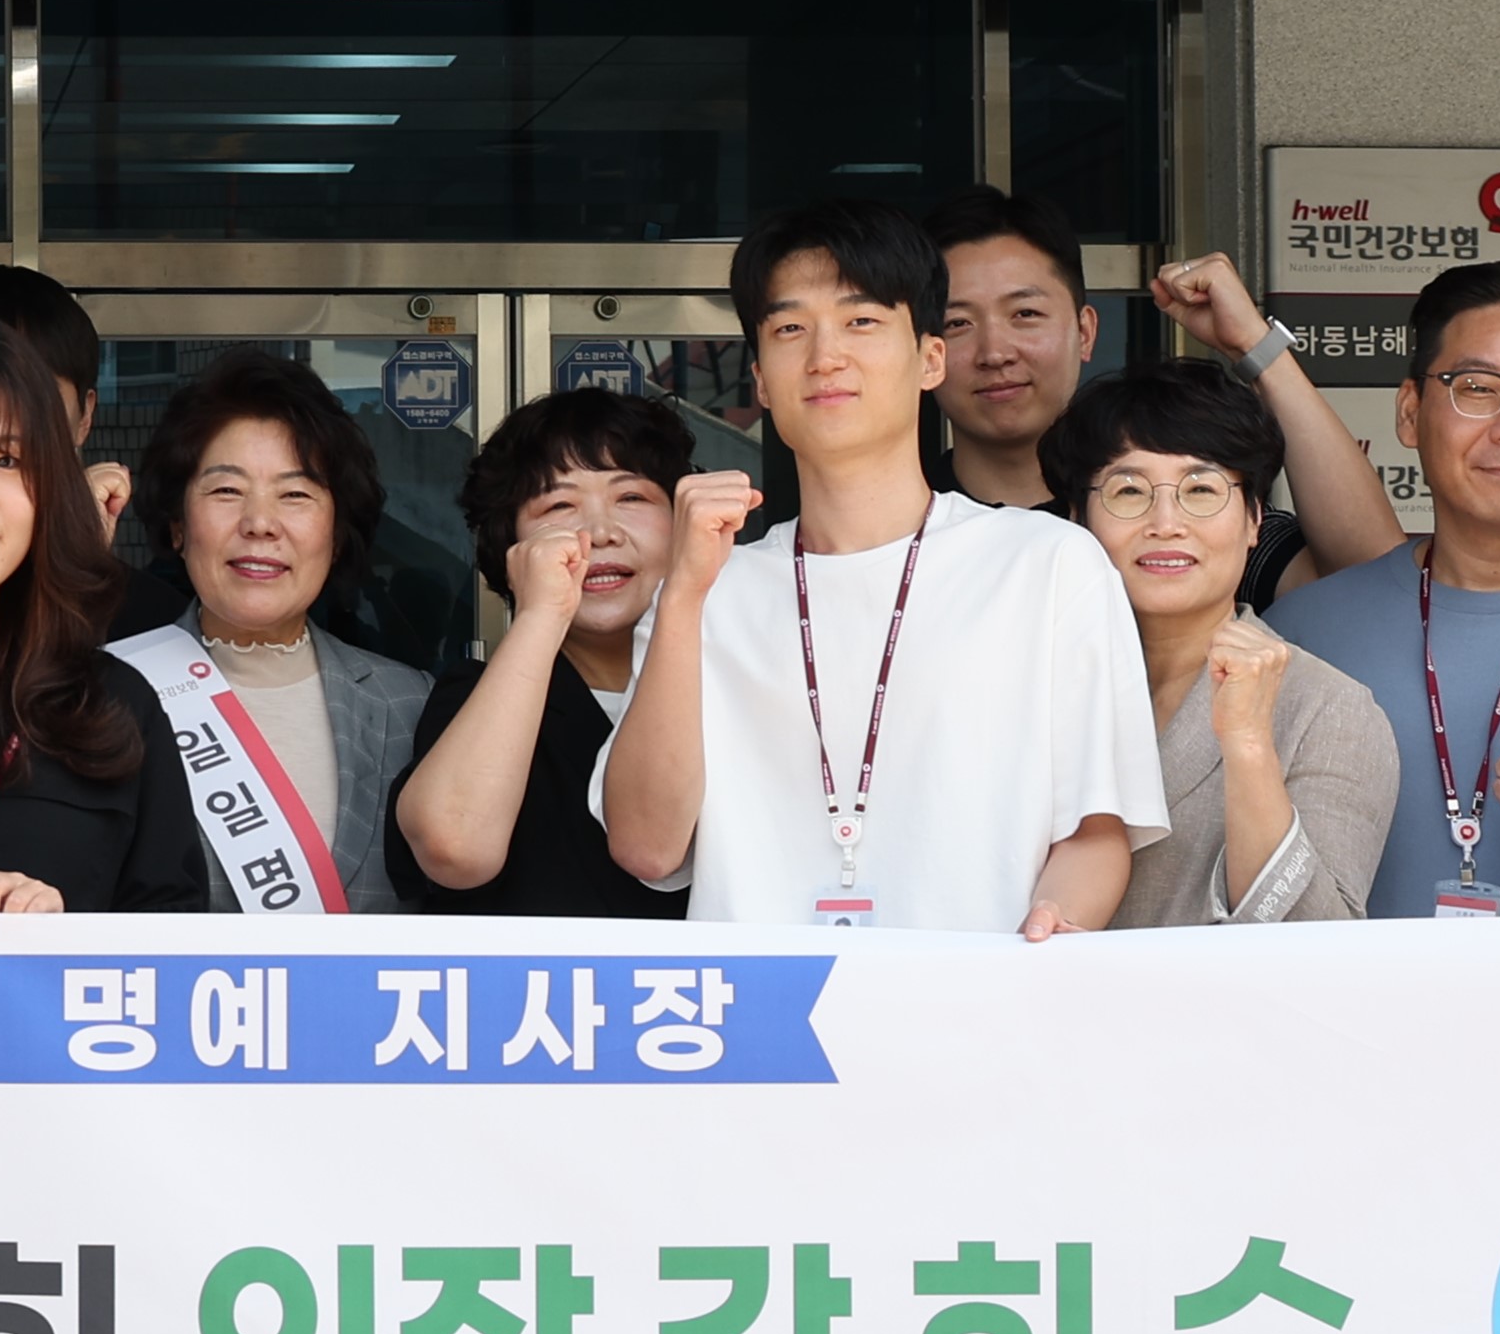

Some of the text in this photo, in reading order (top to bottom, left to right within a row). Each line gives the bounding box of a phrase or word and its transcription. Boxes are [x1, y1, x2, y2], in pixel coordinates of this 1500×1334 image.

[1287, 223, 1480, 260] 국민건강보험
[1289, 262, 1336, 273] National
[1340, 262, 1376, 273] Health
[1379, 263, 1432, 274] Insurance
[1293, 325, 1416, 357] 하동남해
[396, 369, 458, 401] ADT
[63, 967, 288, 1072] 명예
[375, 967, 735, 1072] 지사장
